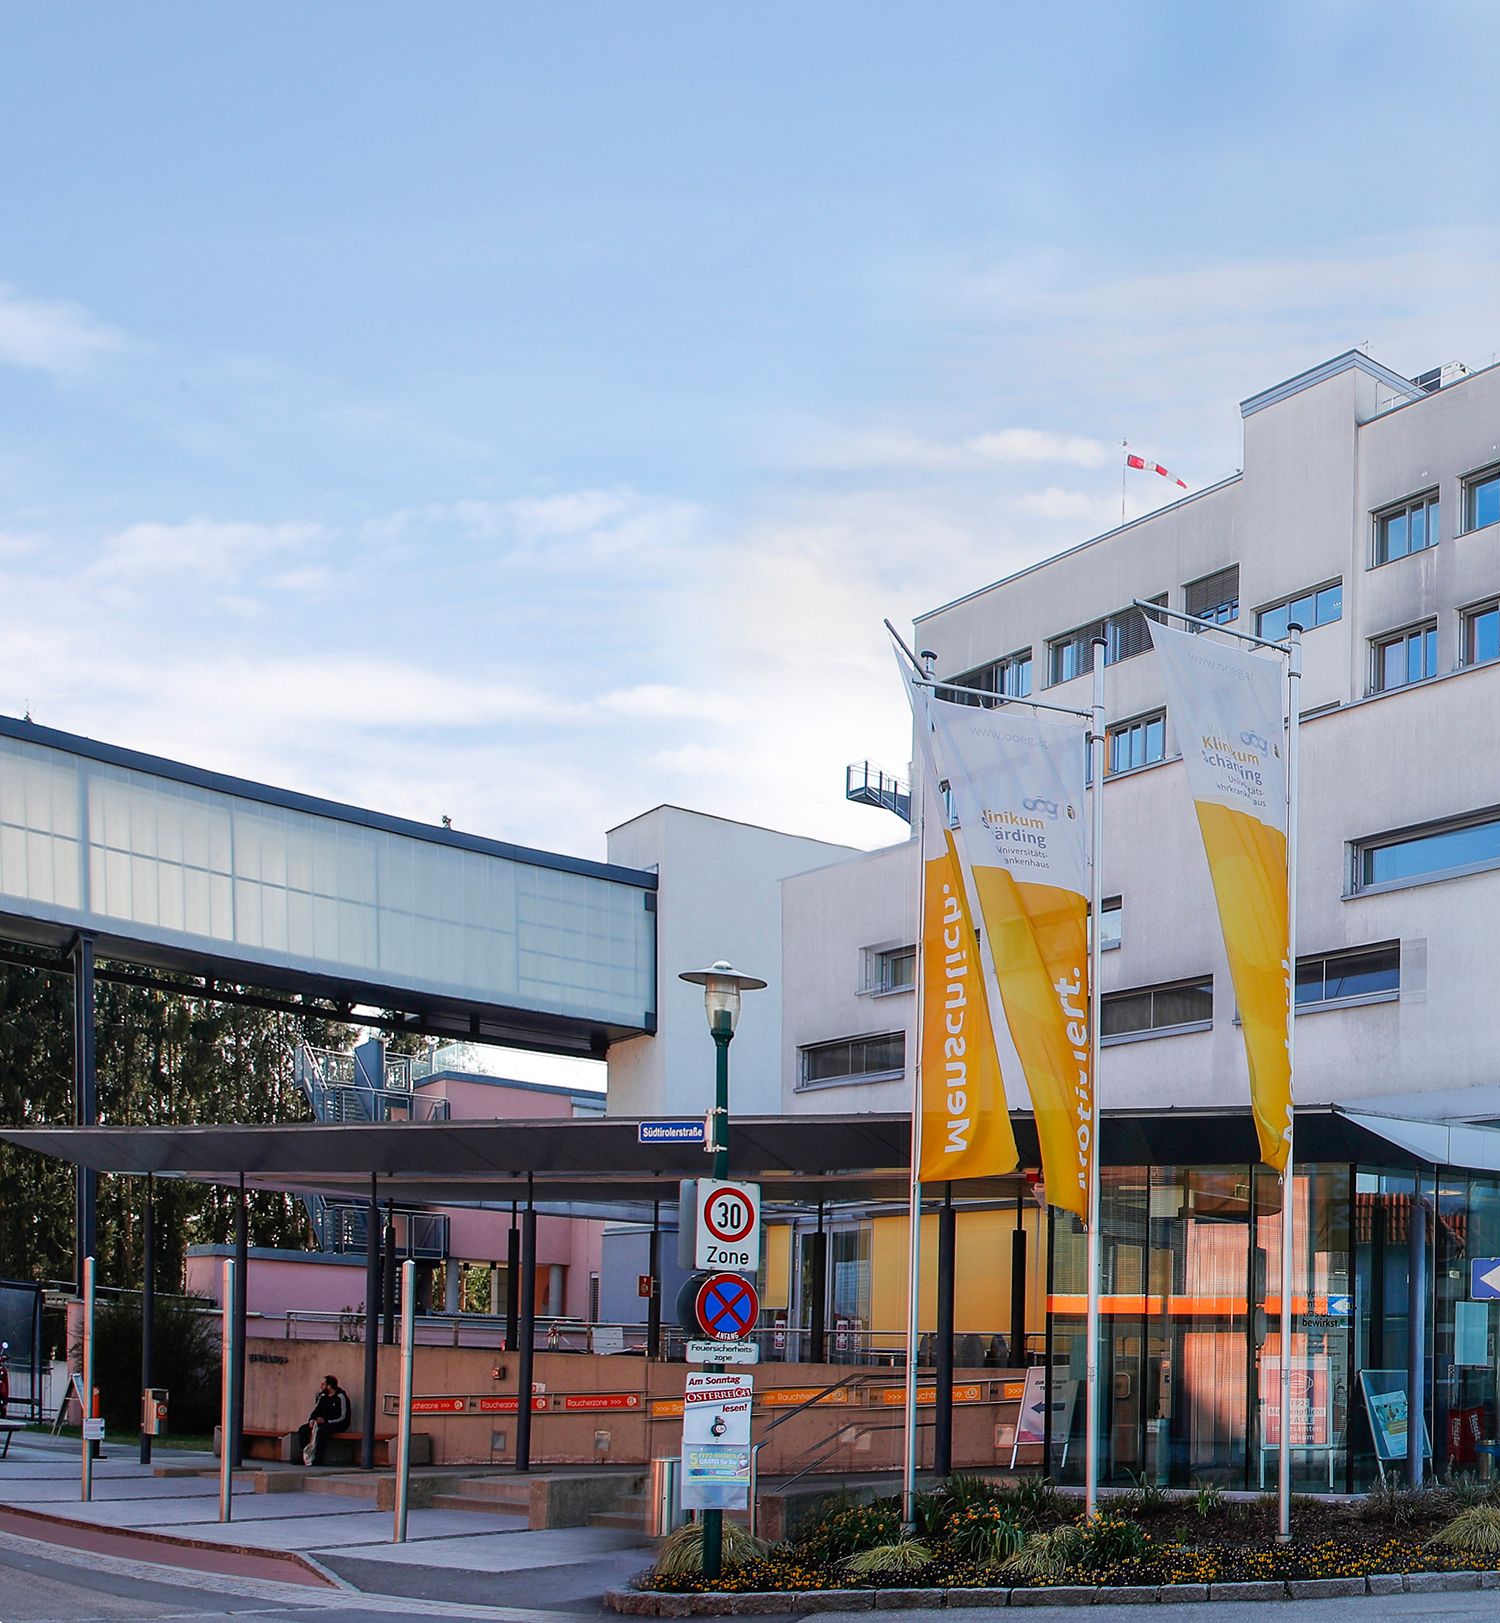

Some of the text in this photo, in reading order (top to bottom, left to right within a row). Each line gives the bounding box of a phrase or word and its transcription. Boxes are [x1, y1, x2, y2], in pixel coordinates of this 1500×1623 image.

[642, 1127, 703, 1138] Südtirolerstraße
[717, 1202, 742, 1229] 30
[707, 1246, 749, 1265] Zone
[716, 1331, 740, 1340] ANFANG
[691, 1344, 755, 1354] Feuersicherheits-
[714, 1354, 733, 1363] zone
[706, 1376, 741, 1385] Sonntag
[687, 1388, 750, 1402] ÖSTERREICH
[567, 1400, 608, 1408] Raucherzone
[722, 1403, 748, 1412] lesen!
